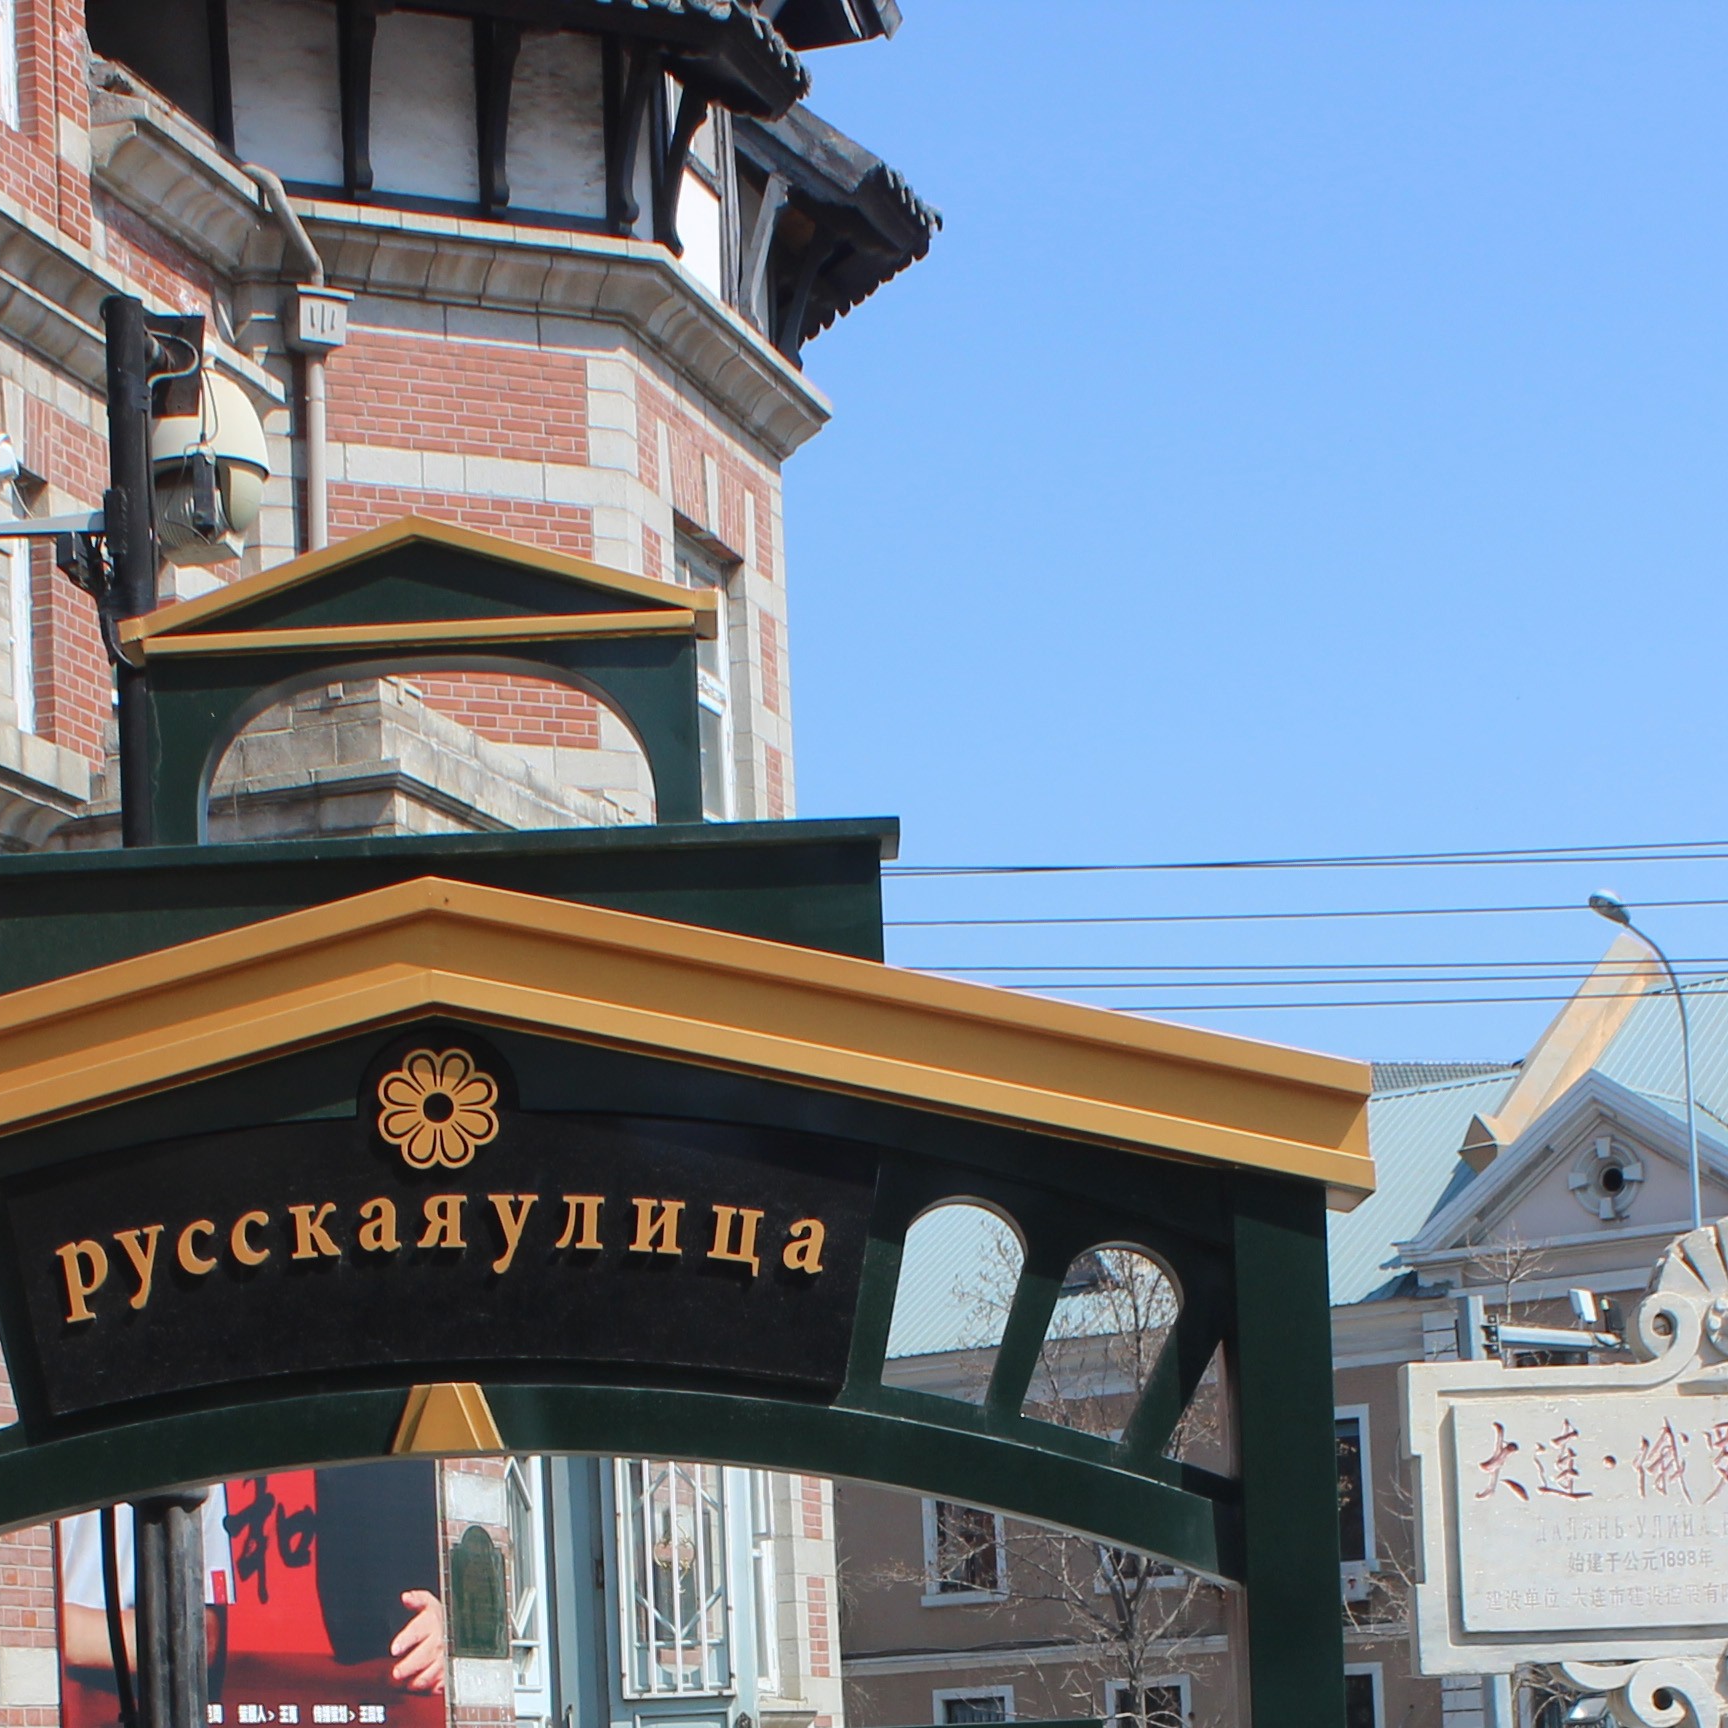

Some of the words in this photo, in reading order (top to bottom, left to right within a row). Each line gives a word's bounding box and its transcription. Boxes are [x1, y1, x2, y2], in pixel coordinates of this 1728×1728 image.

[1569, 1548, 1713, 1573] 始建于公元1898年
